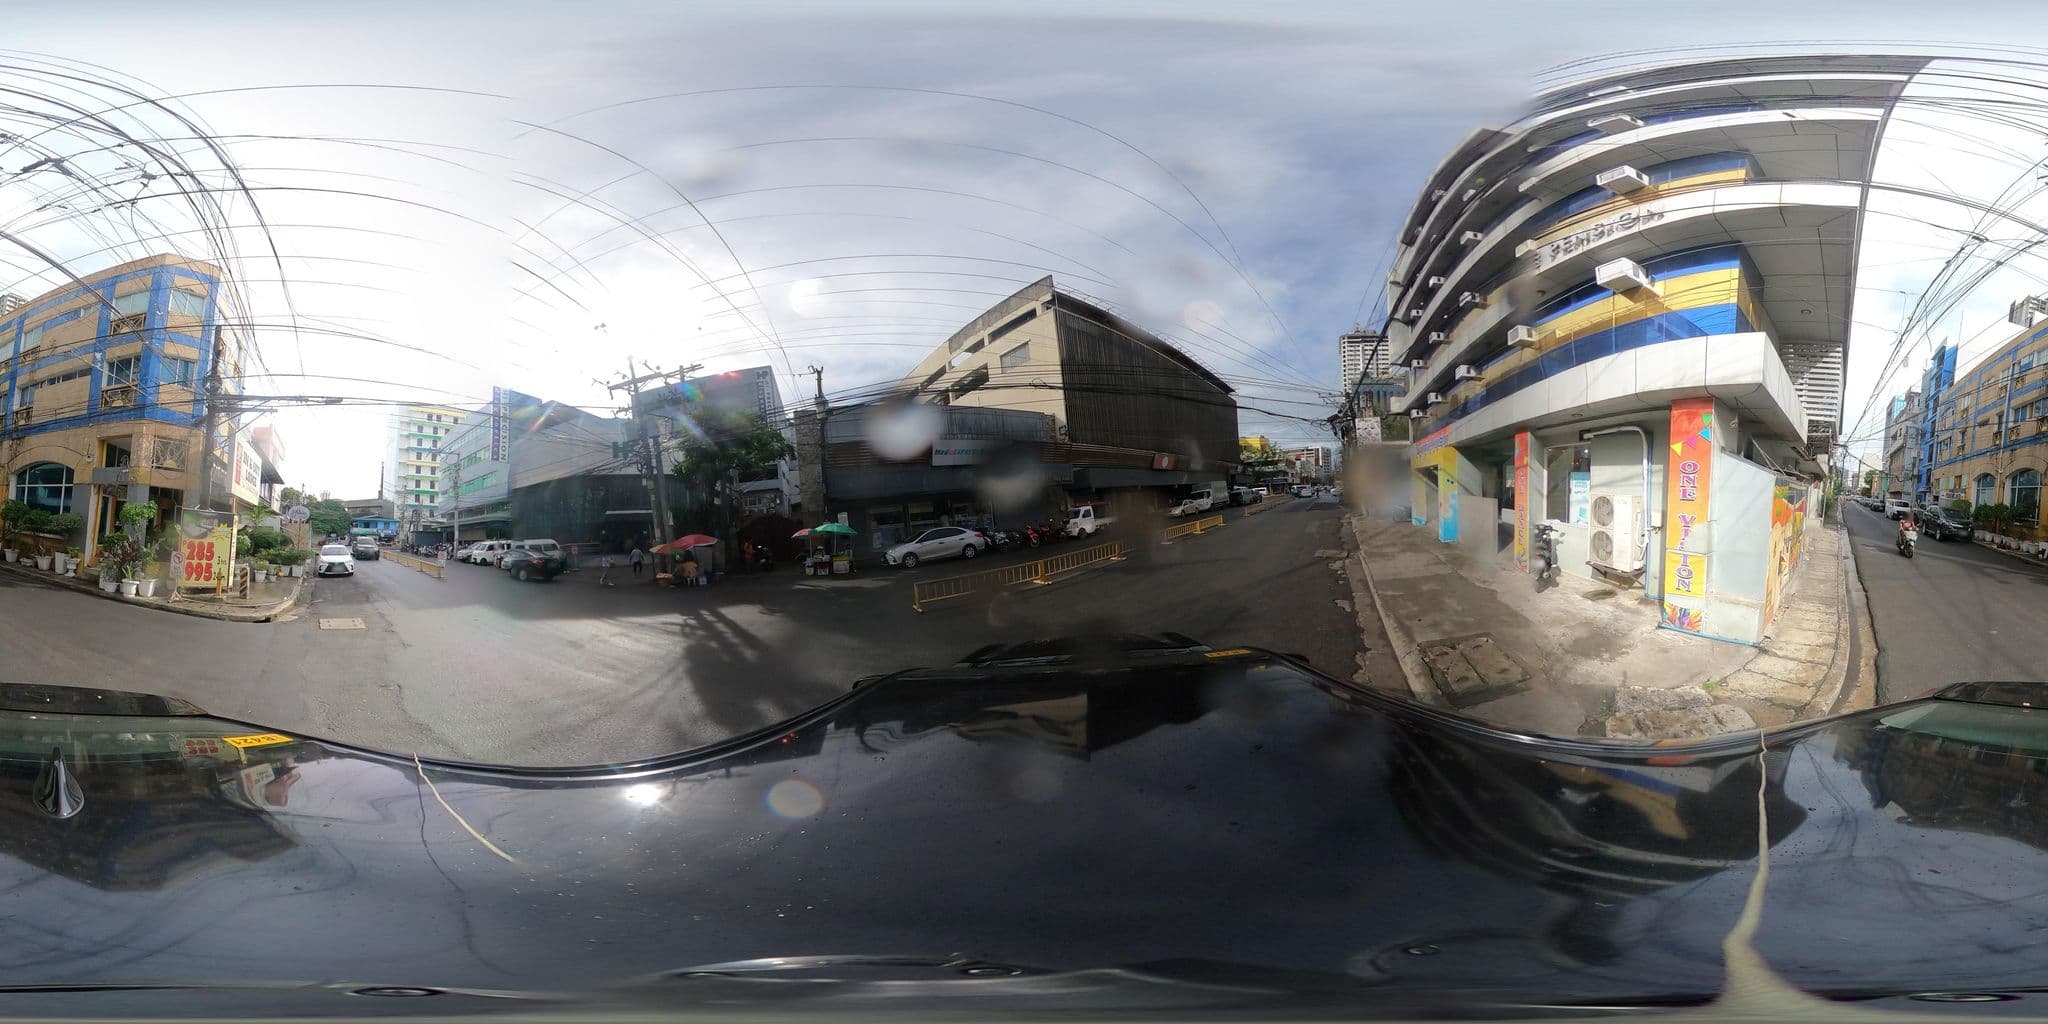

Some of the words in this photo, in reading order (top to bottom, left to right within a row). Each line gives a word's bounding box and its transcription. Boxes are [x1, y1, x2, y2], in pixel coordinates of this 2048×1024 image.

[1550, 209, 1665, 262] PENSION
[1680, 460, 1699, 501] ONE
[186, 540, 214, 561] 285
[184, 561, 213, 582] 995
